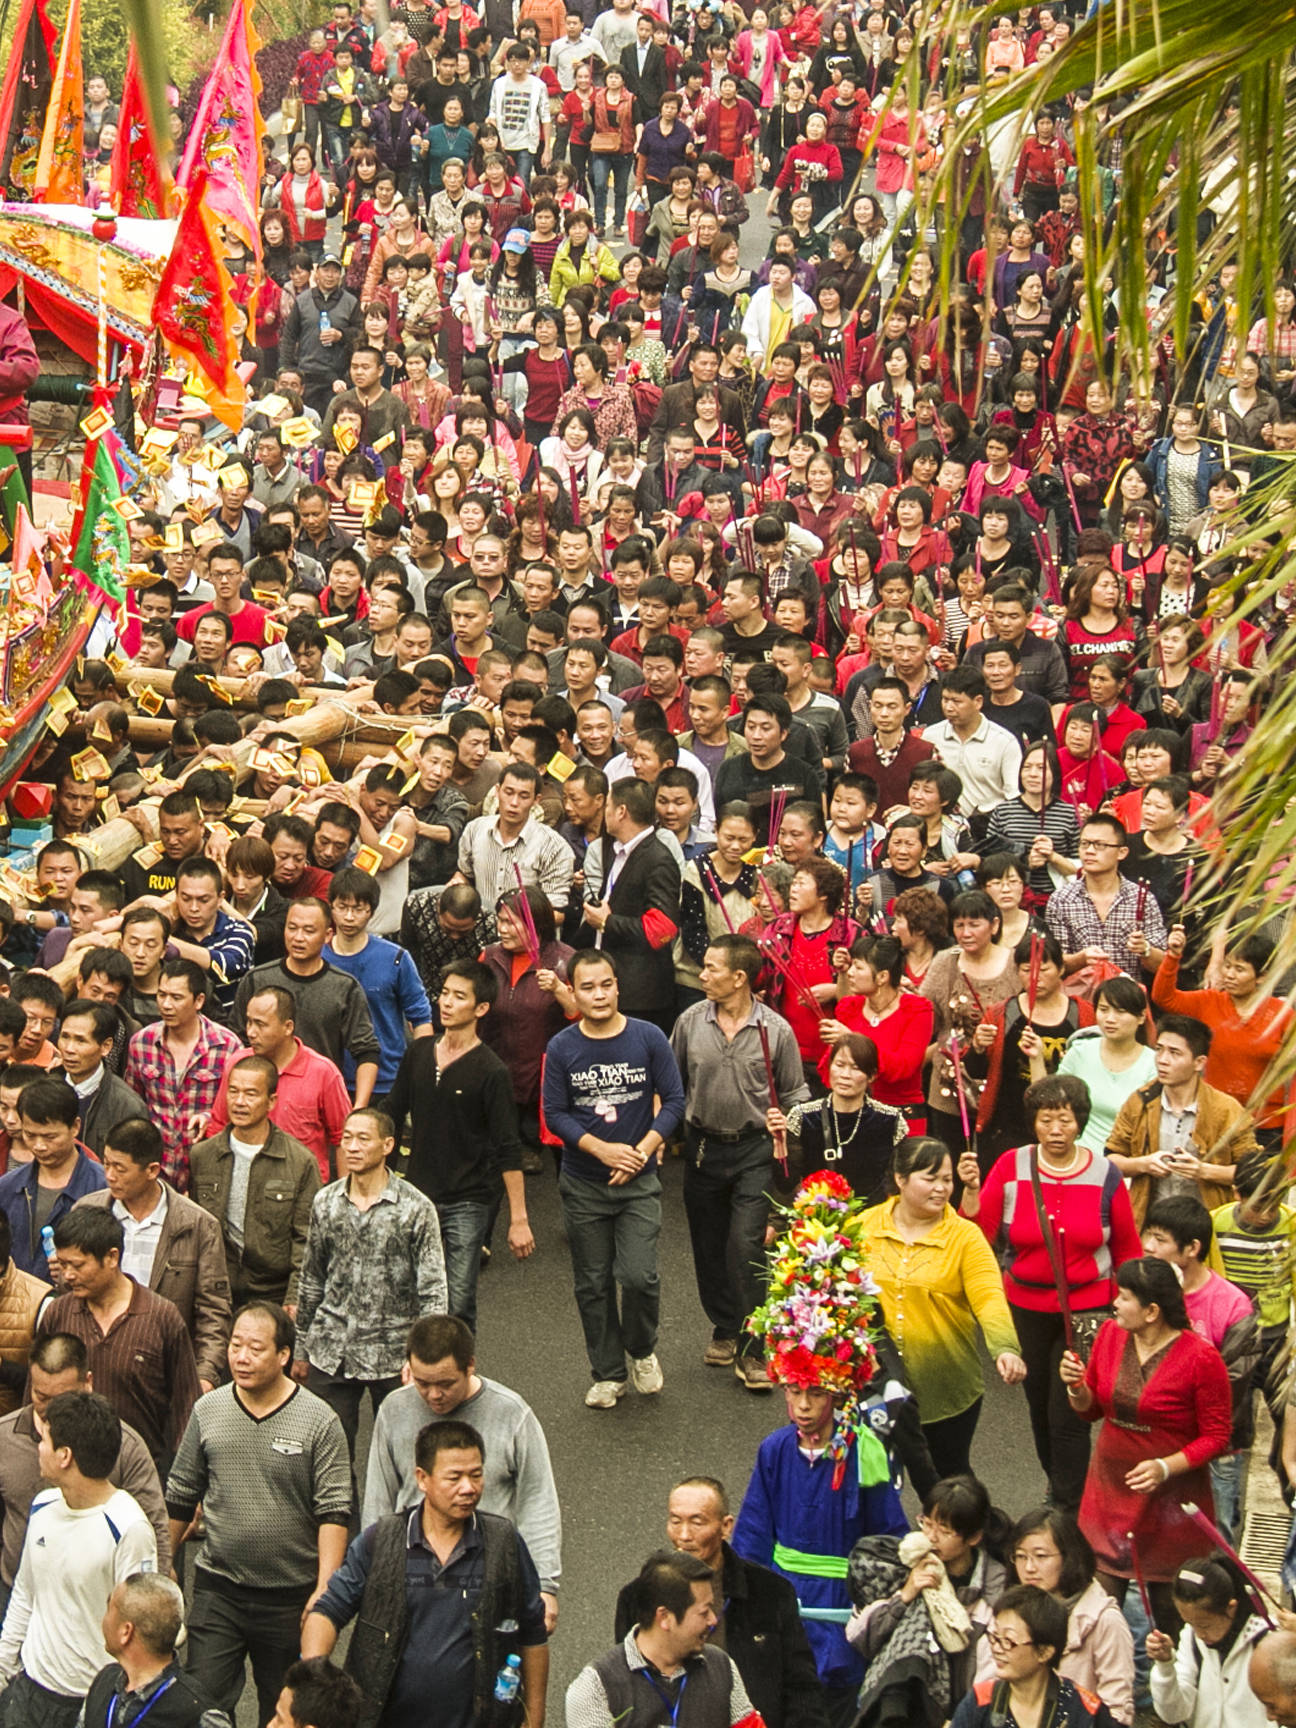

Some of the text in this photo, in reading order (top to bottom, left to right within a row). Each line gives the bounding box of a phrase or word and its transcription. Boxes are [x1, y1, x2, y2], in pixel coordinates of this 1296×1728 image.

[148, 874, 177, 890] RUN
[571, 1071, 598, 1081] XIAO
[598, 1076, 623, 1086] XIAO
[625, 1073, 646, 1084] TIAN
